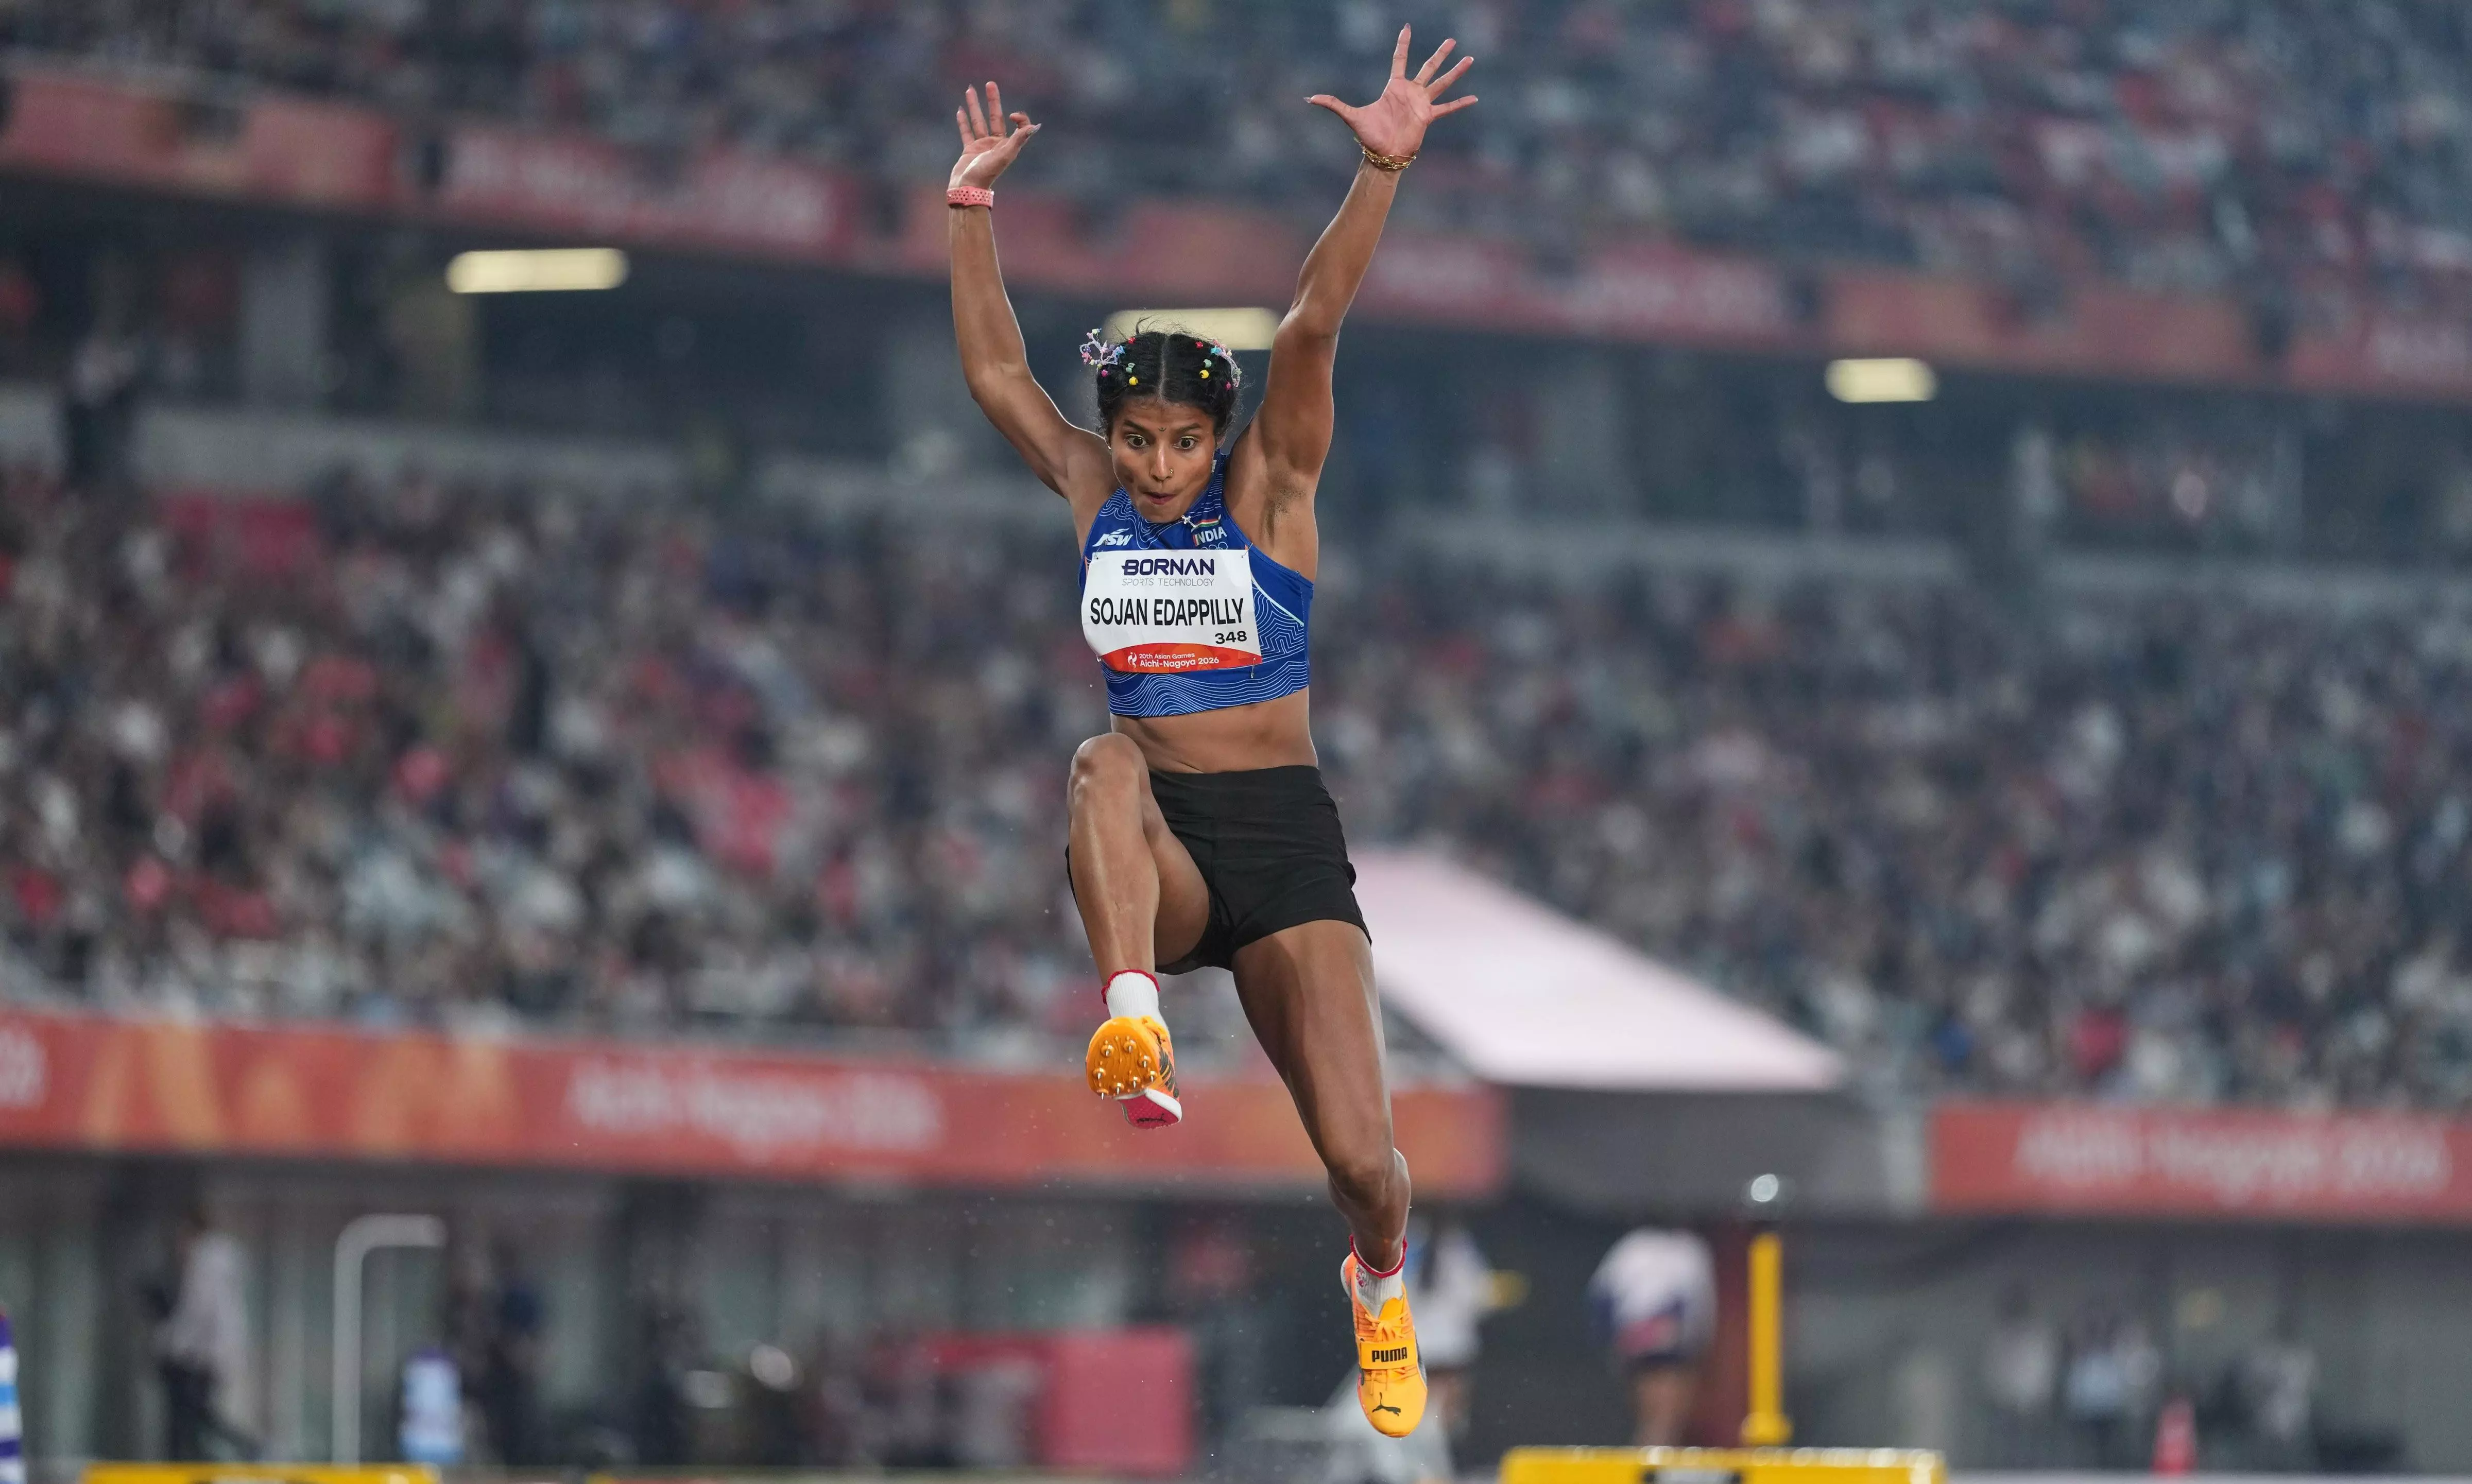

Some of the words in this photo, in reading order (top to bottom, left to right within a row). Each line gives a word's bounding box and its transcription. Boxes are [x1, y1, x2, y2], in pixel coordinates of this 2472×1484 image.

[1193, 526, 1227, 546] INDIA
[1121, 558, 1214, 575] BORNAN
[1090, 597, 1147, 625] SOJAN
[1154, 598, 1244, 626] EDAPPILLY
[1215, 631, 1247, 644] 348
[1140, 659, 1196, 668] Aichi-Nagoya
[1371, 1347, 1407, 1362] PUMA
